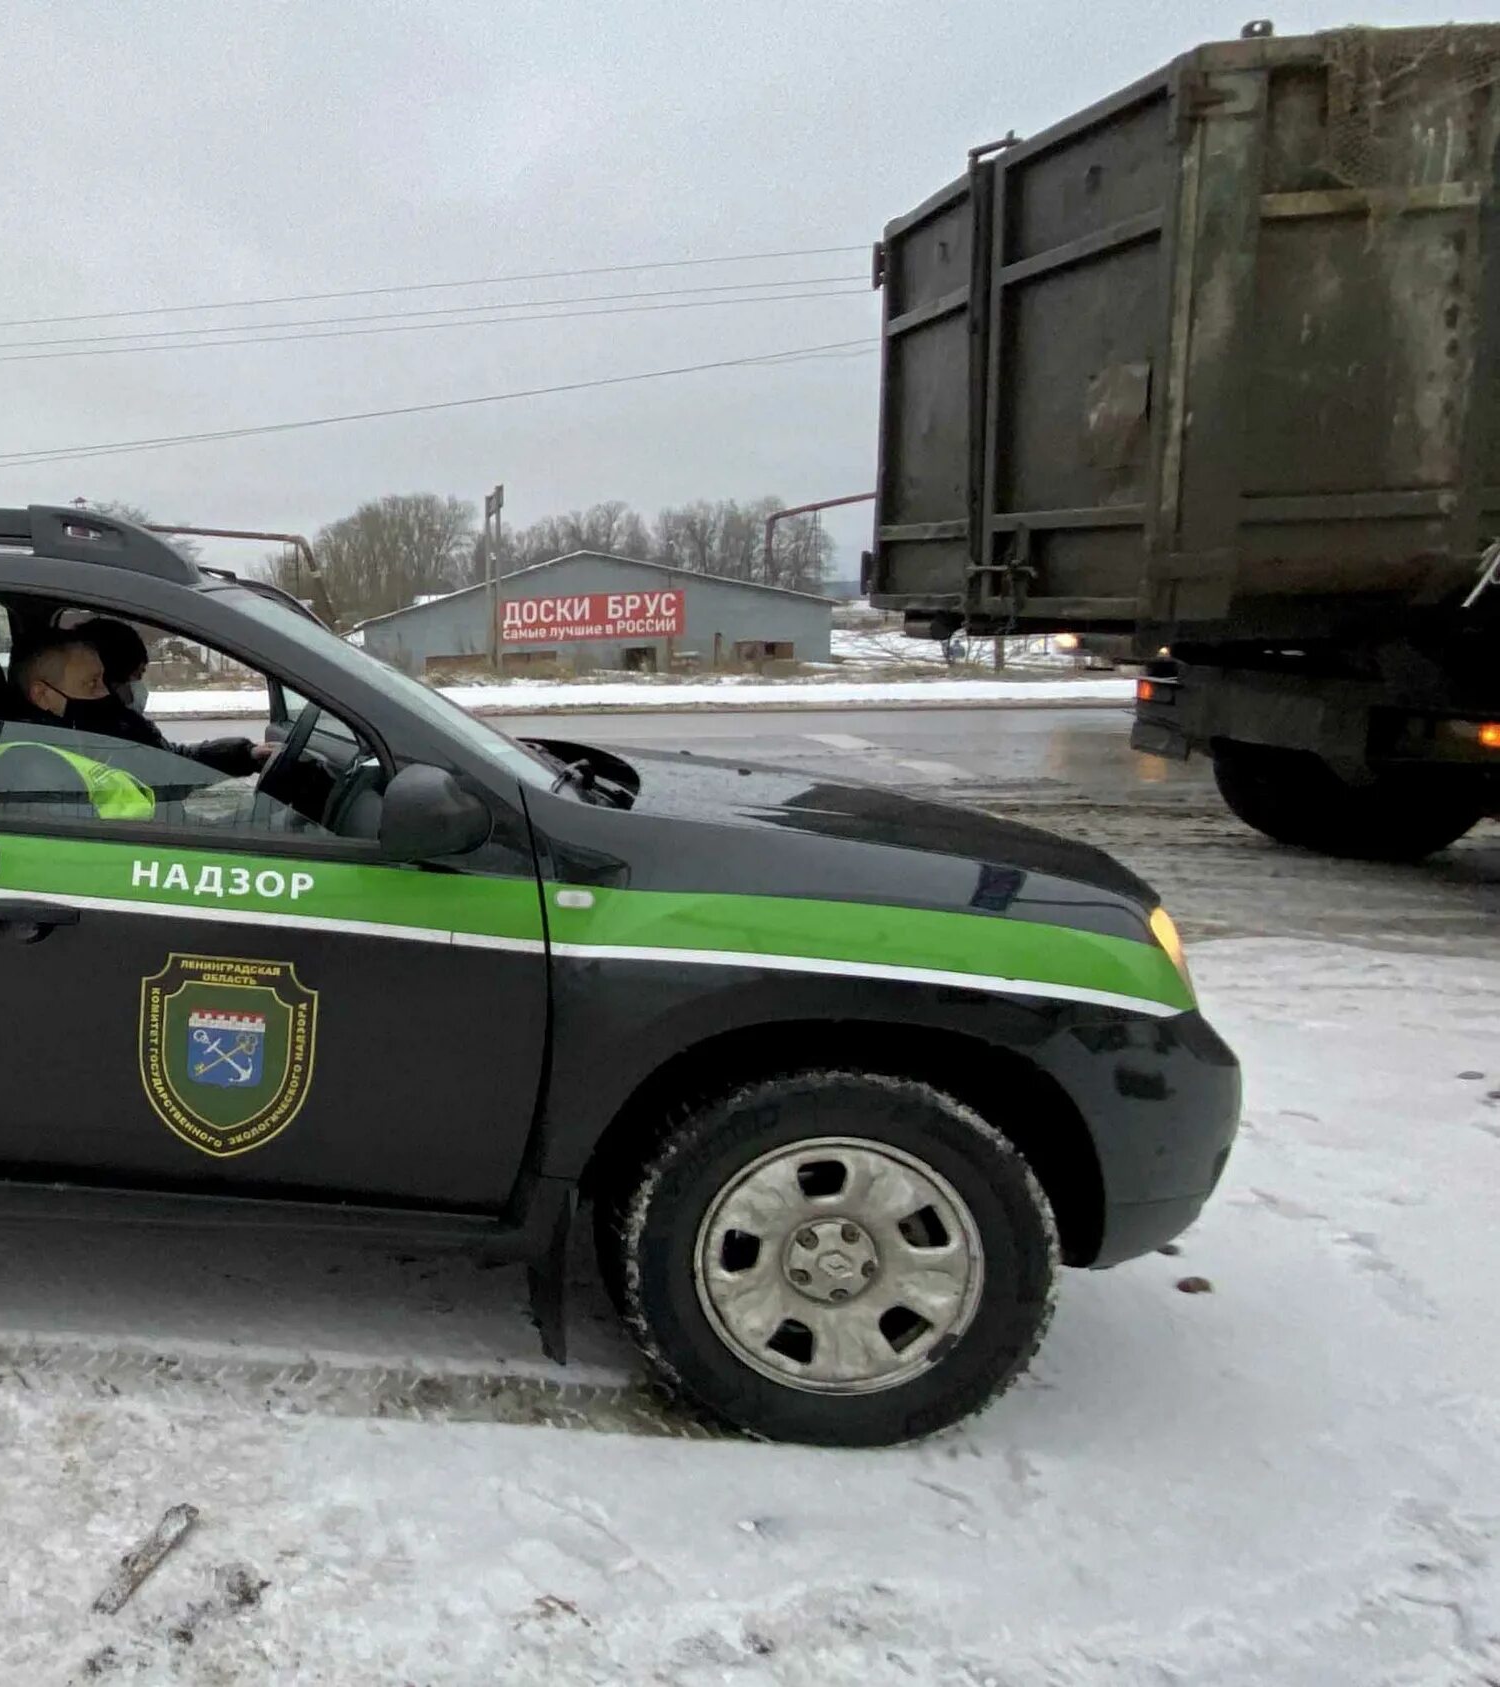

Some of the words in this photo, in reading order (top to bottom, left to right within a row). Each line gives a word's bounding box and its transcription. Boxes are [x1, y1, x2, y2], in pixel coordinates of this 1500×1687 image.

[503, 597, 590, 628] ДОСКИ
[607, 593, 676, 619] БРУС
[503, 627, 546, 640] самые
[550, 624, 602, 640] лучшие
[605, 624, 614, 635] в
[616, 617, 676, 634] РОССИИ
[131, 860, 315, 900] НАДЗОР
[180, 960, 281, 976] ЛЕНИНГРАДСКАЯ
[202, 973, 257, 985] ОБЛАСТЬ
[149, 987, 161, 1044] КОМИТЕТ
[295, 1002, 308, 1061] НАДЗОРА
[149, 1047, 223, 1148] ГОСУДАРСТВЕННОГО
[228, 1064, 303, 1144] ЭКОЛОГИЧЕСКОГО
